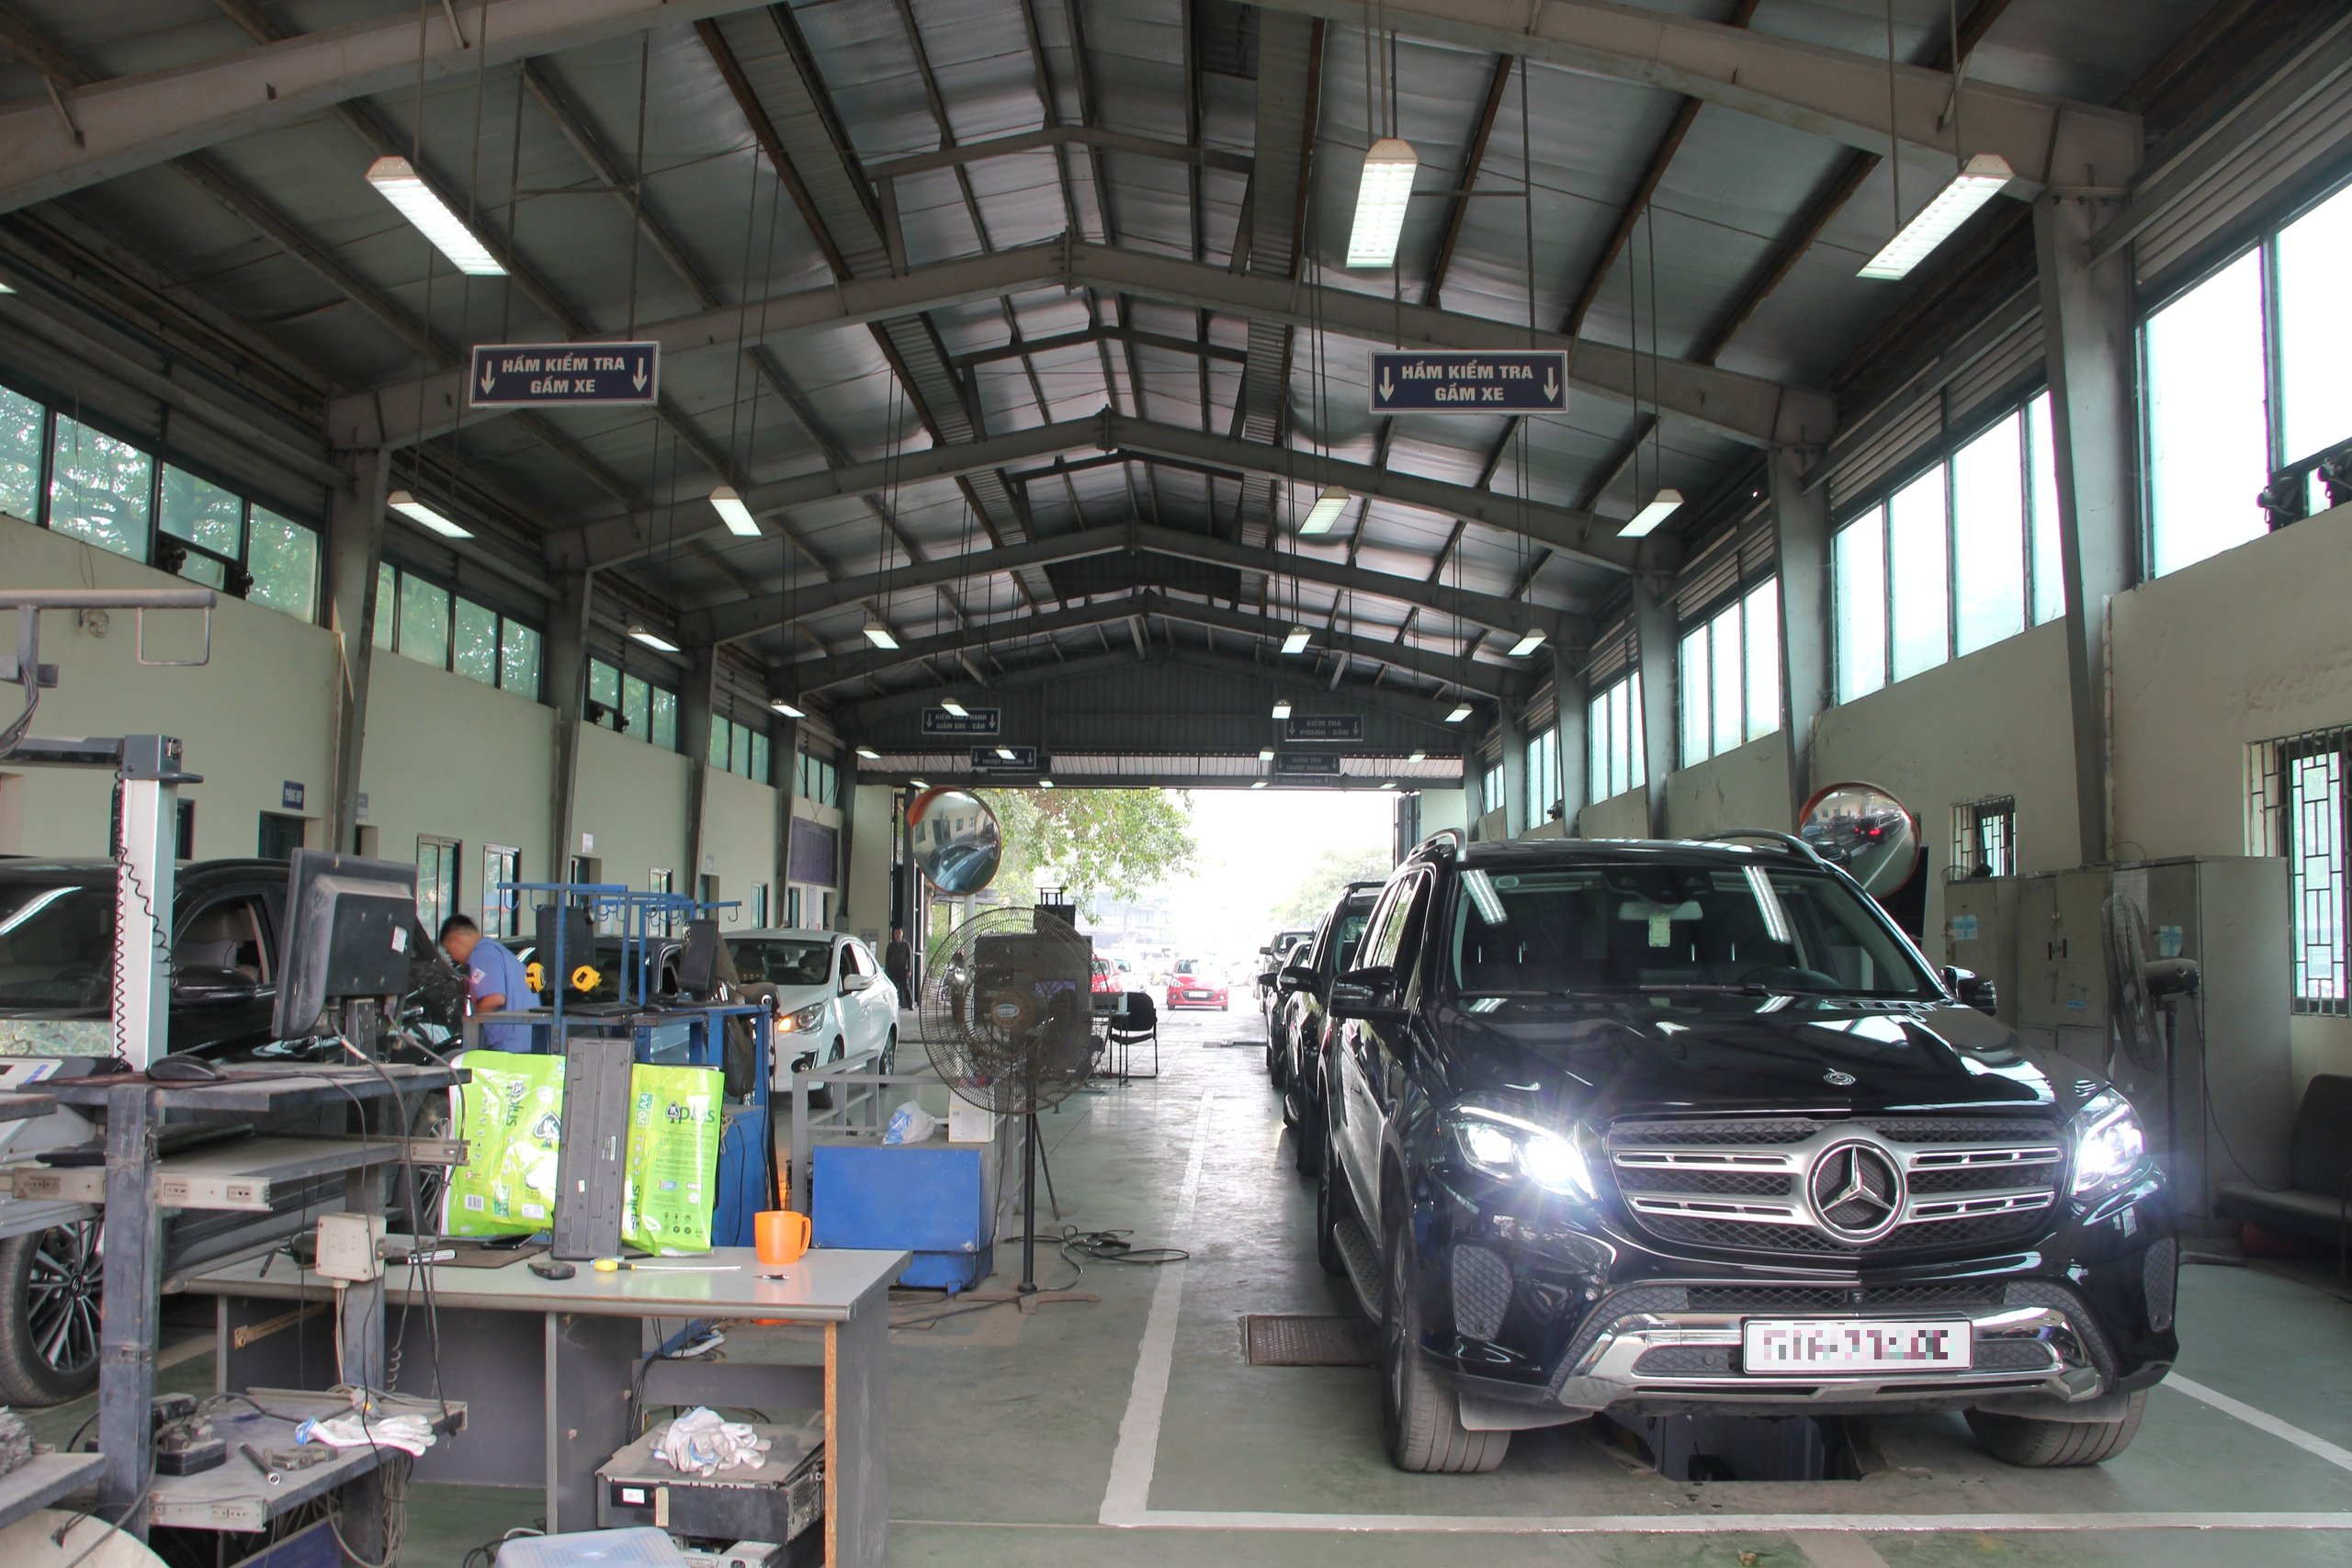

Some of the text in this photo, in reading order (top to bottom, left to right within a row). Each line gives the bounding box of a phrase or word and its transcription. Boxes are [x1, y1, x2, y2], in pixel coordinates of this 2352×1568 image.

[545, 352, 589, 372] KIỂM
[594, 356, 626, 371] TRA
[1448, 359, 1494, 379] KIỂM
[1498, 365, 1533, 379] TRA
[573, 378, 596, 393] XE
[1481, 387, 1505, 401] XE
